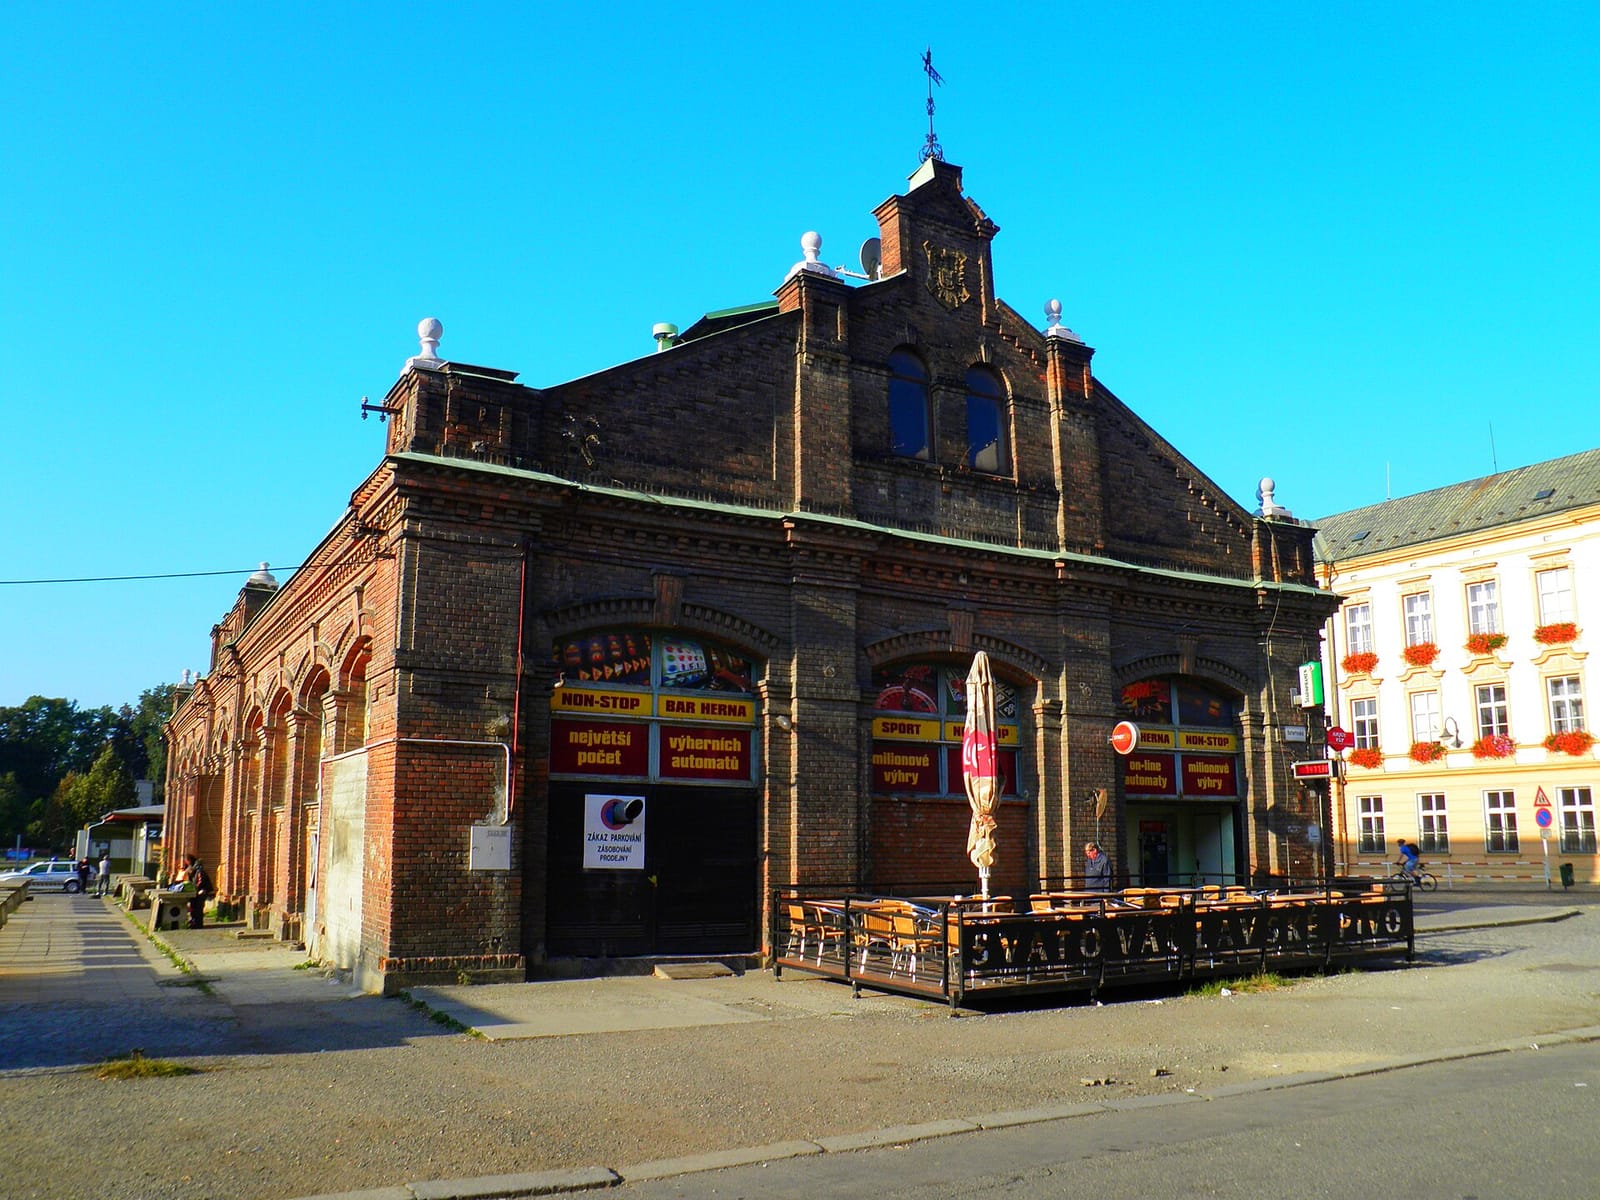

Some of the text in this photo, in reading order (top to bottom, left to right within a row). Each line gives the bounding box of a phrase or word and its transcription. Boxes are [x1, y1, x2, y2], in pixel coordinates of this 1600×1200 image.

[562, 693, 640, 710] NON-STOP
[666, 700, 747, 717] BAR HERNA
[882, 722, 921, 735] SPORT
[569, 730, 631, 746] největší
[669, 735, 742, 752] výherních
[1140, 732, 1170, 745] HERNA
[1186, 735, 1229, 747] NON-STOP
[578, 750, 621, 766] počet
[671, 755, 739, 770] automatů
[872, 752, 929, 767] milionové
[1129, 760, 1162, 771] on-line
[1188, 762, 1230, 774] milionové
[884, 769, 919, 785] výhry
[1125, 774, 1168, 789] automaty
[1197, 777, 1223, 790] výhry
[587, 832, 642, 843] ZÁKAZ PARKOVÁNÍ
[597, 844, 632, 853] ZÁSOBOVÁNÍ
[600, 854, 629, 862] PRODEJNY
[1339, 908, 1401, 939] PIVO
